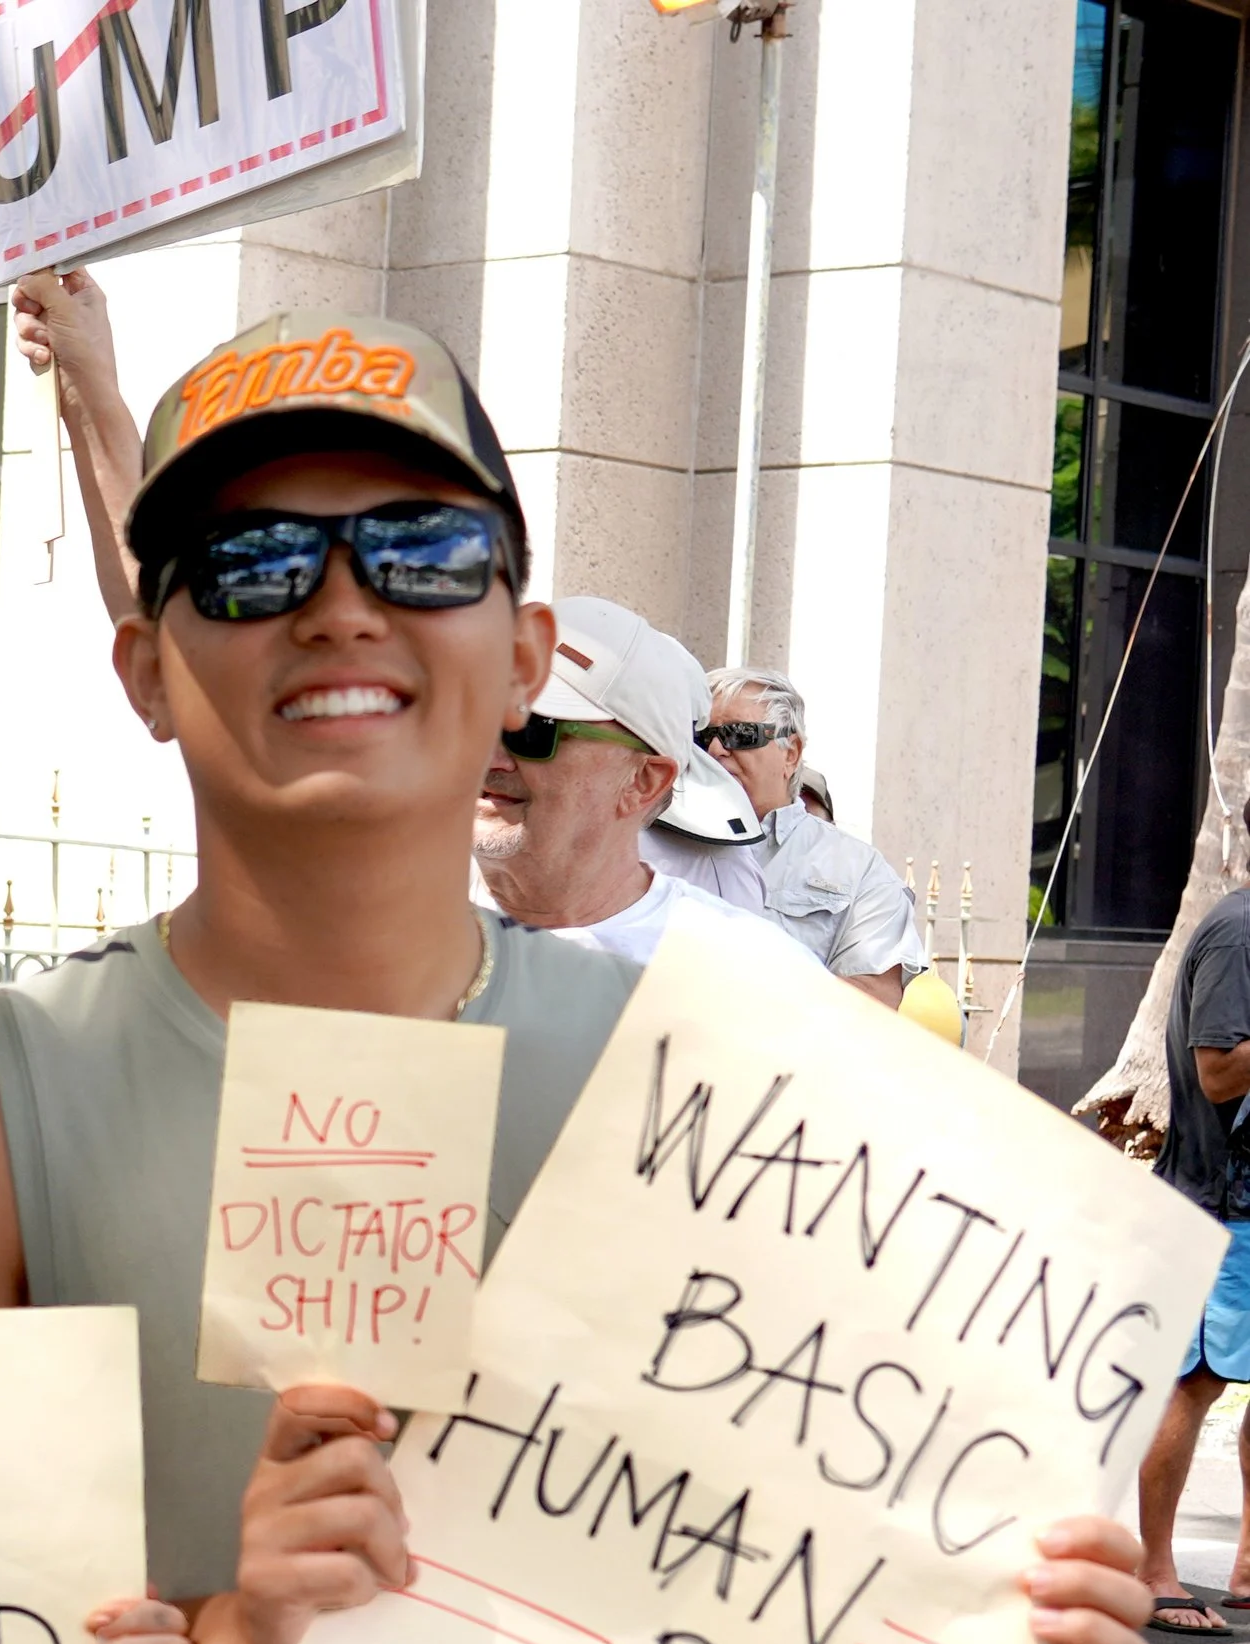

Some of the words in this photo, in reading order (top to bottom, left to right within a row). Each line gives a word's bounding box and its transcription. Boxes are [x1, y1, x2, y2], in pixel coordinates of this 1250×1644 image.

[282, 1092, 382, 1148] NO
[220, 1196, 481, 1280] DICTATOR
[635, 1034, 1161, 1467] WANTING
[260, 1274, 432, 1345] SHIP!
[642, 1268, 1033, 1555] BASIC
